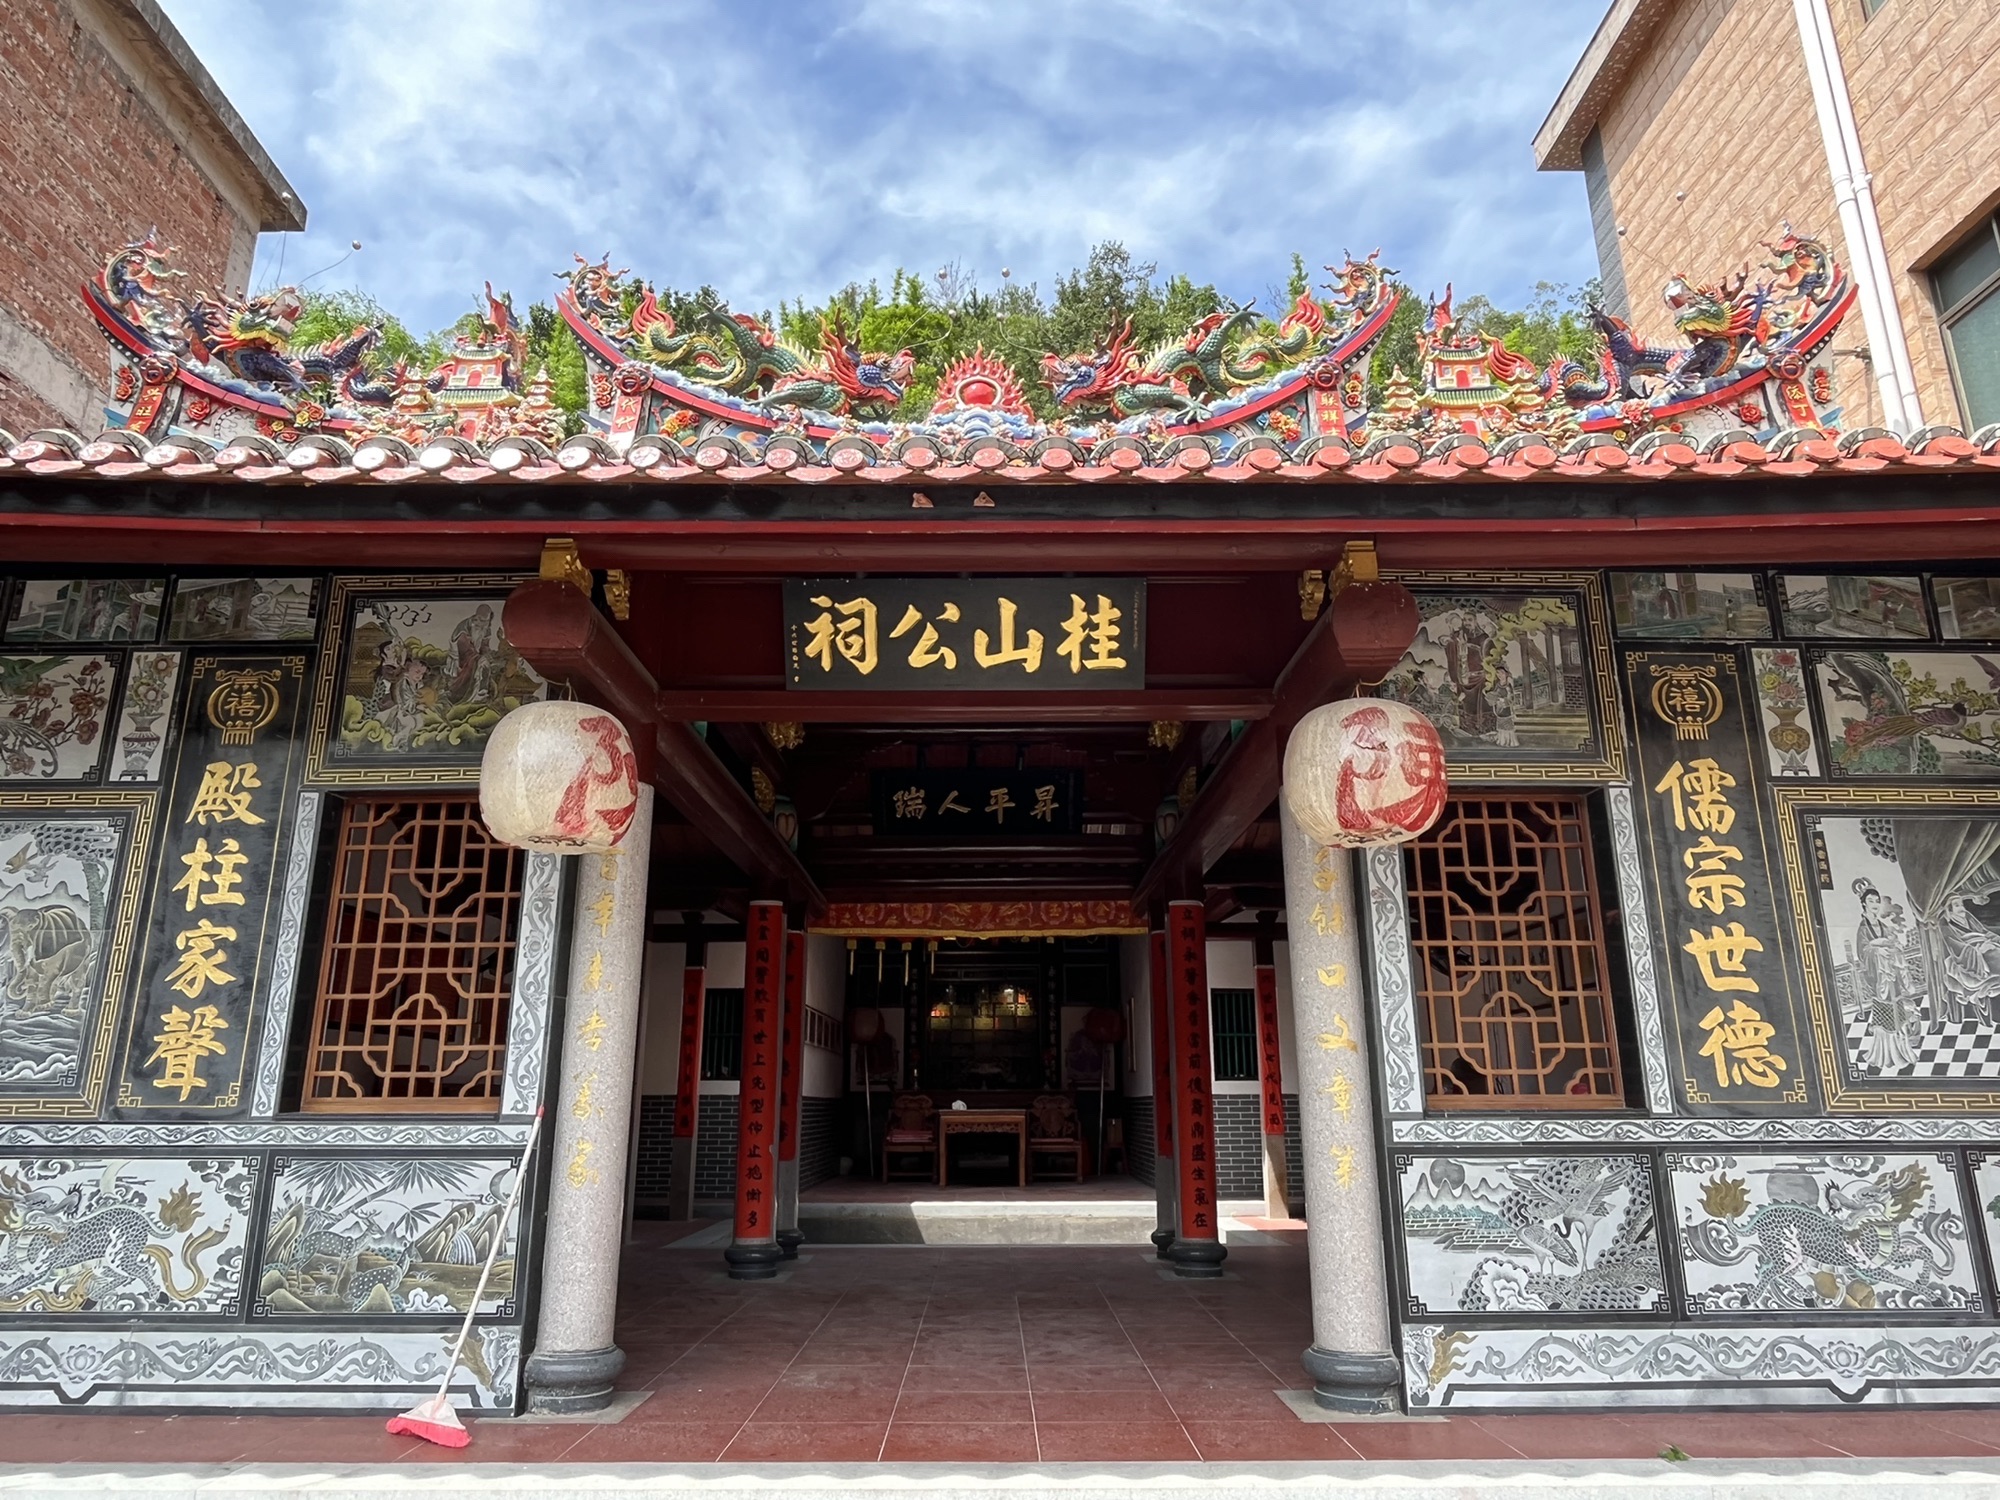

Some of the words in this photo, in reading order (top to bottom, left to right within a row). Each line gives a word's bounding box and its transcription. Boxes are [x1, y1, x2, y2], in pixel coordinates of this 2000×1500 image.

[804, 594, 1127, 675] 桂山公祠
[1668, 686, 1706, 712] 禧
[893, 785, 1059, 824] 昇平人瑞
[143, 761, 266, 1102] 殿柱家聲
[1655, 757, 1788, 1089] 儒宗世德
